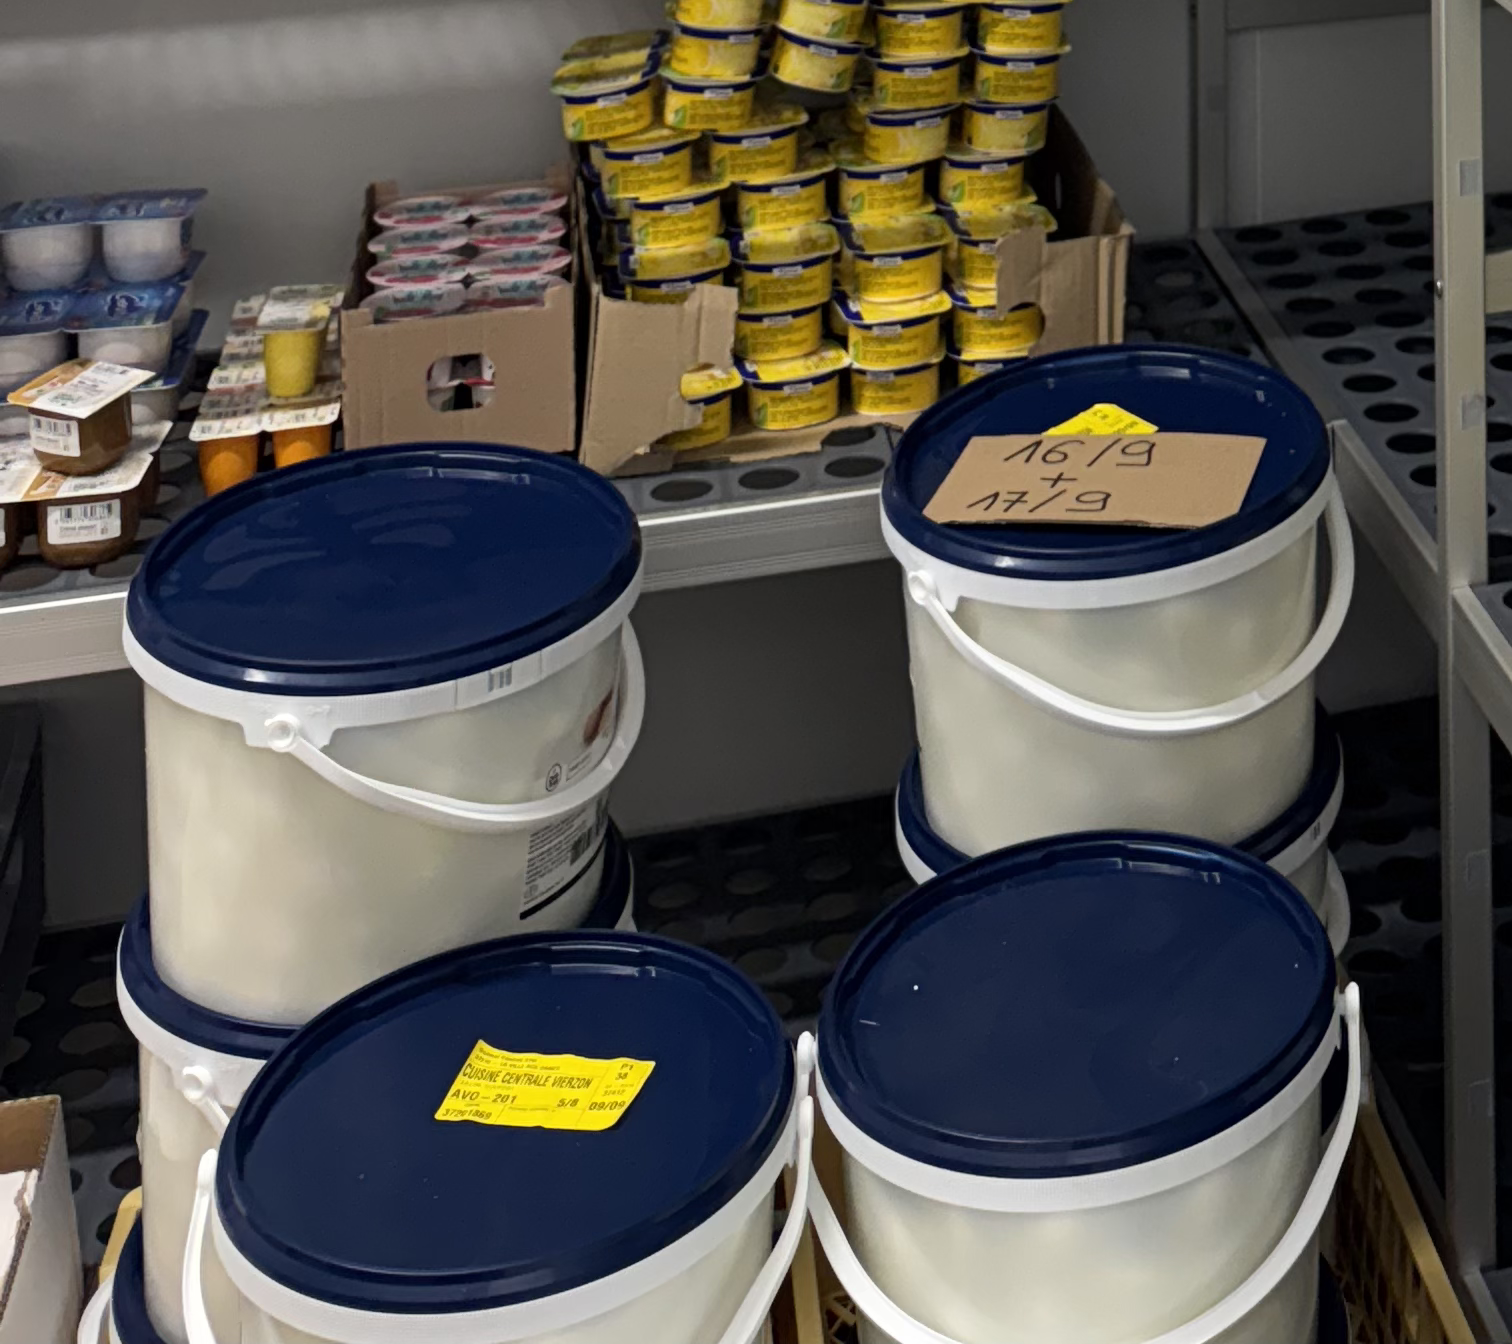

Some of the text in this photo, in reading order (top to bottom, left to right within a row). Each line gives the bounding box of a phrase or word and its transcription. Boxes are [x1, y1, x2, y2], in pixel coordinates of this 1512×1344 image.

[1003, 437, 1157, 468] 16/9
[966, 488, 1113, 514] 17/9
[462, 1062, 594, 1089] CUISINE CENTRALE VIERZON
[450, 1088, 518, 1105] AVO 201
[556, 1097, 580, 1108] 5/8
